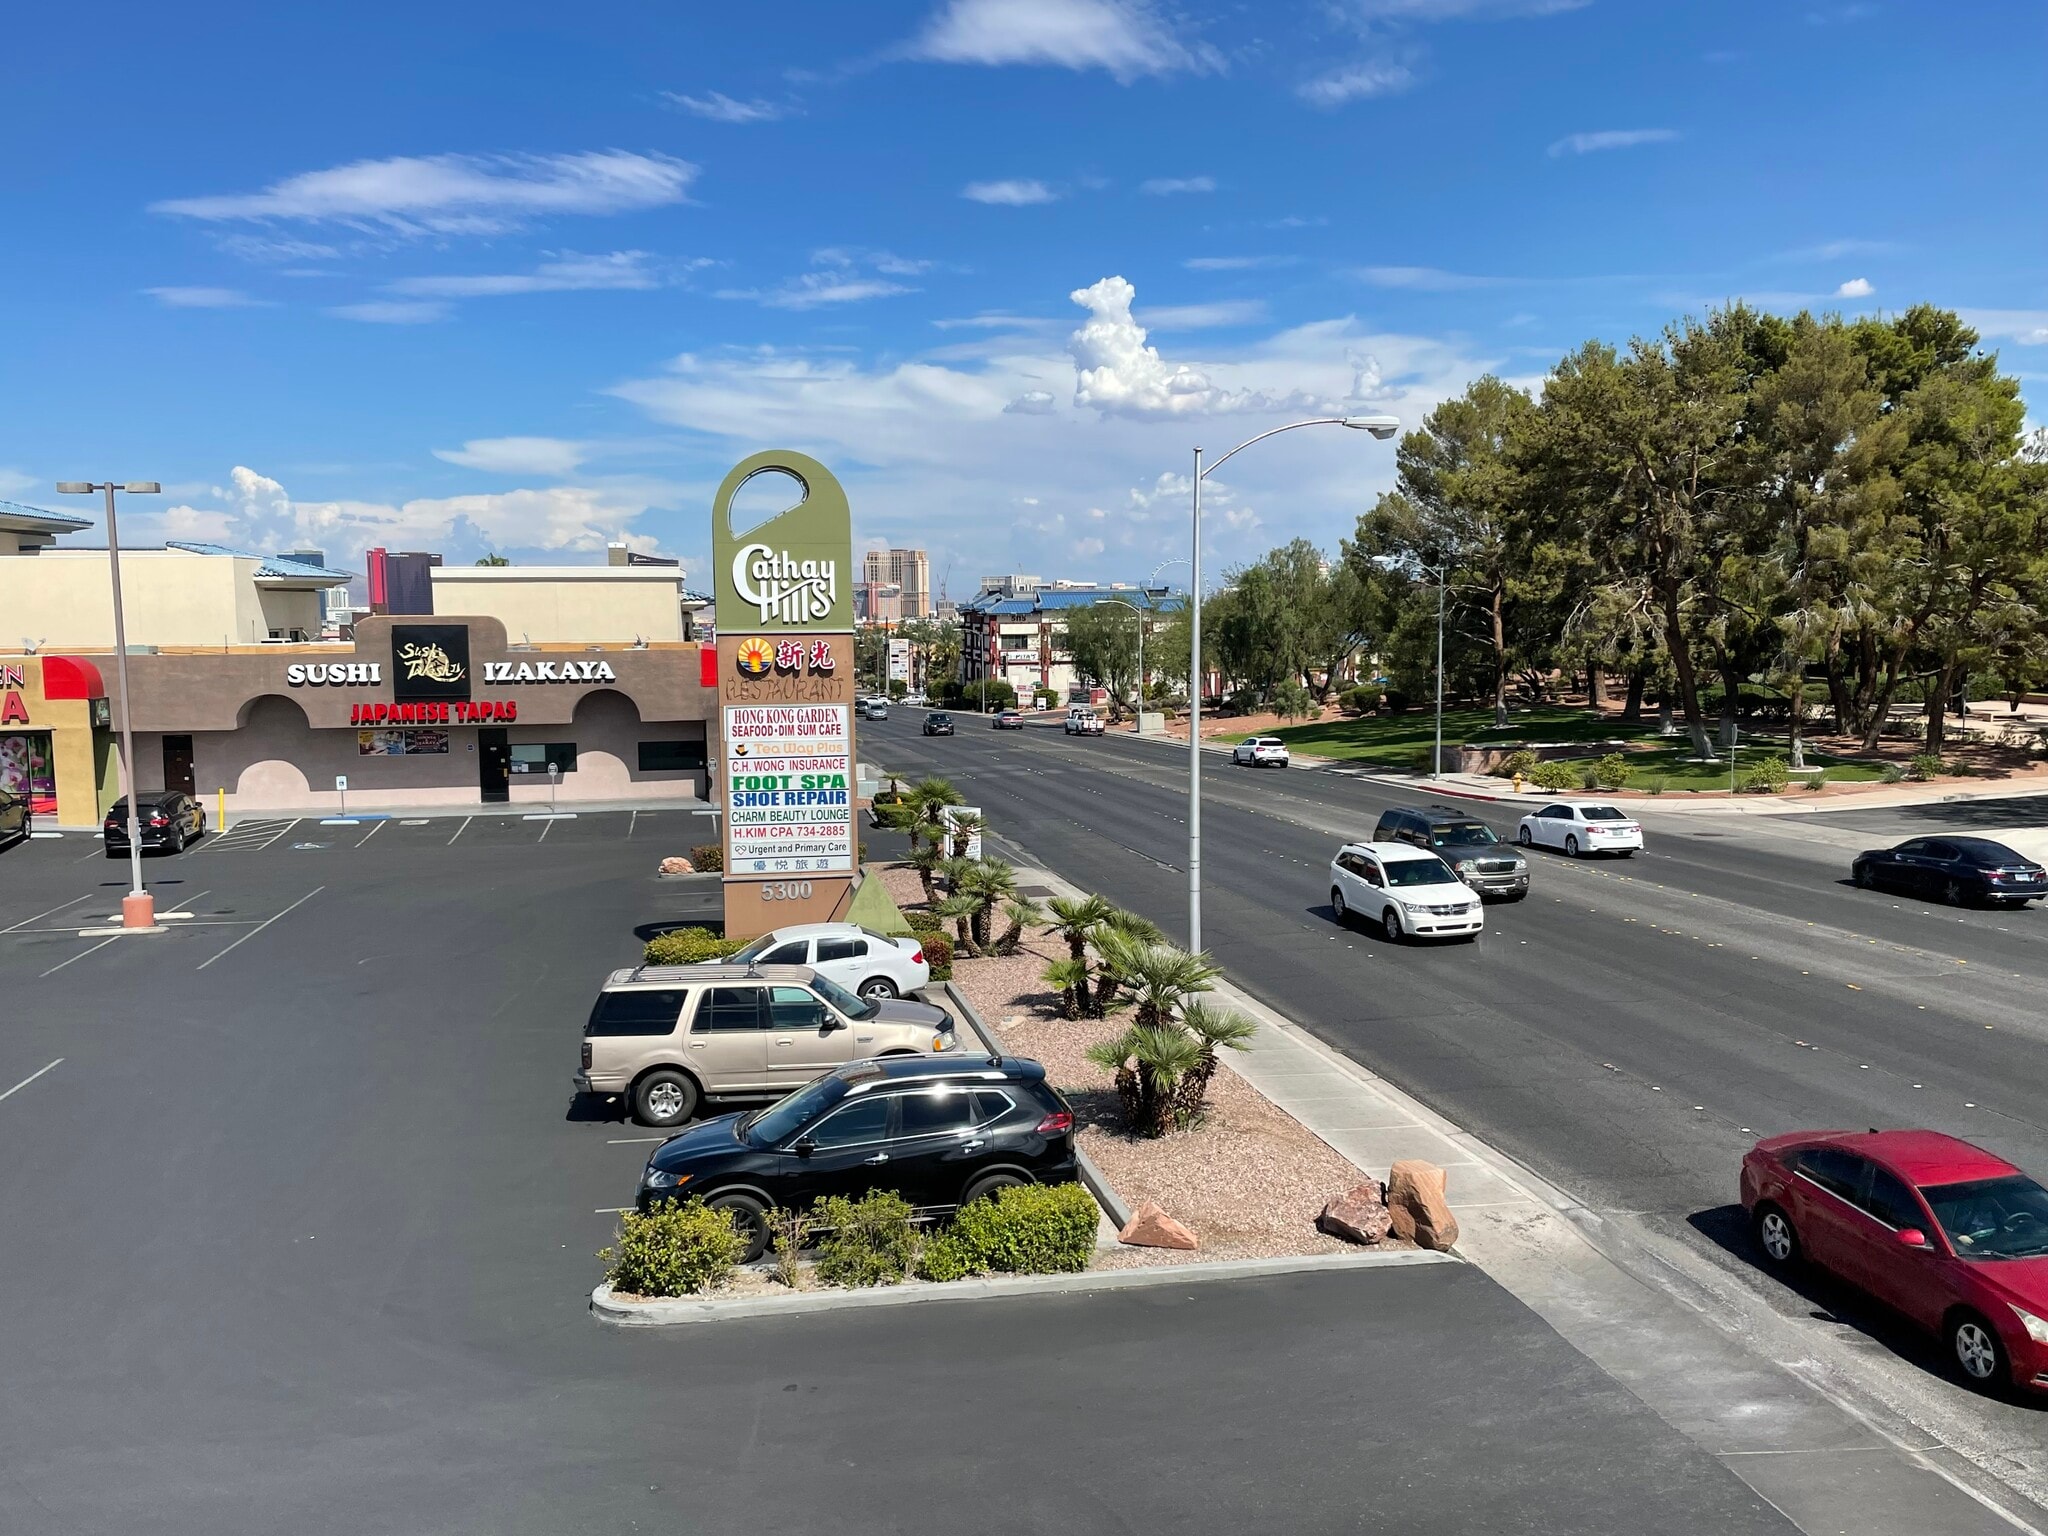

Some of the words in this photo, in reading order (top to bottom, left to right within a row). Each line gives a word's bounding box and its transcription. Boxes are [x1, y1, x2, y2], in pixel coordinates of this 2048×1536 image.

[732, 543, 836, 605] Cathay
[759, 578, 831, 624] Hills
[396, 642, 445, 659] Sushi
[776, 640, 836, 669] 新光
[287, 663, 381, 684] SUSHI
[483, 661, 616, 682] IZAKAYA
[726, 678, 844, 700] RESTAURANT
[350, 702, 449, 722] JAPANESE
[455, 701, 517, 721] TAPAS
[734, 710, 764, 724] HONG
[766, 709, 794, 724] KONG
[797, 708, 838, 724] GARDEN
[797, 724, 816, 736] SUM
[819, 724, 842, 736] CAFE
[754, 744, 781, 754] Tea
[784, 743, 814, 756] Way
[817, 742, 843, 753] Plus
[732, 761, 752, 772] C.H.
[754, 760, 785, 772] WONG
[789, 758, 846, 770] INSURANCE
[732, 775, 792, 790] FOOT
[801, 774, 846, 788] SPA
[733, 792, 780, 806] SHOE
[784, 791, 846, 806] REPAIR
[732, 810, 766, 822] CHARM
[770, 810, 807, 822] BEAUTY
[810, 808, 849, 820] LOUNGE
[734, 828, 766, 838] H.KIM
[770, 826, 794, 838] CPA
[797, 826, 845, 836] 734-2885
[748, 844, 776, 856] Urgent
[778, 844, 792, 853] and
[795, 843, 826, 854] Primary
[828, 842, 847, 852] Care
[761, 880, 812, 900] 5300
